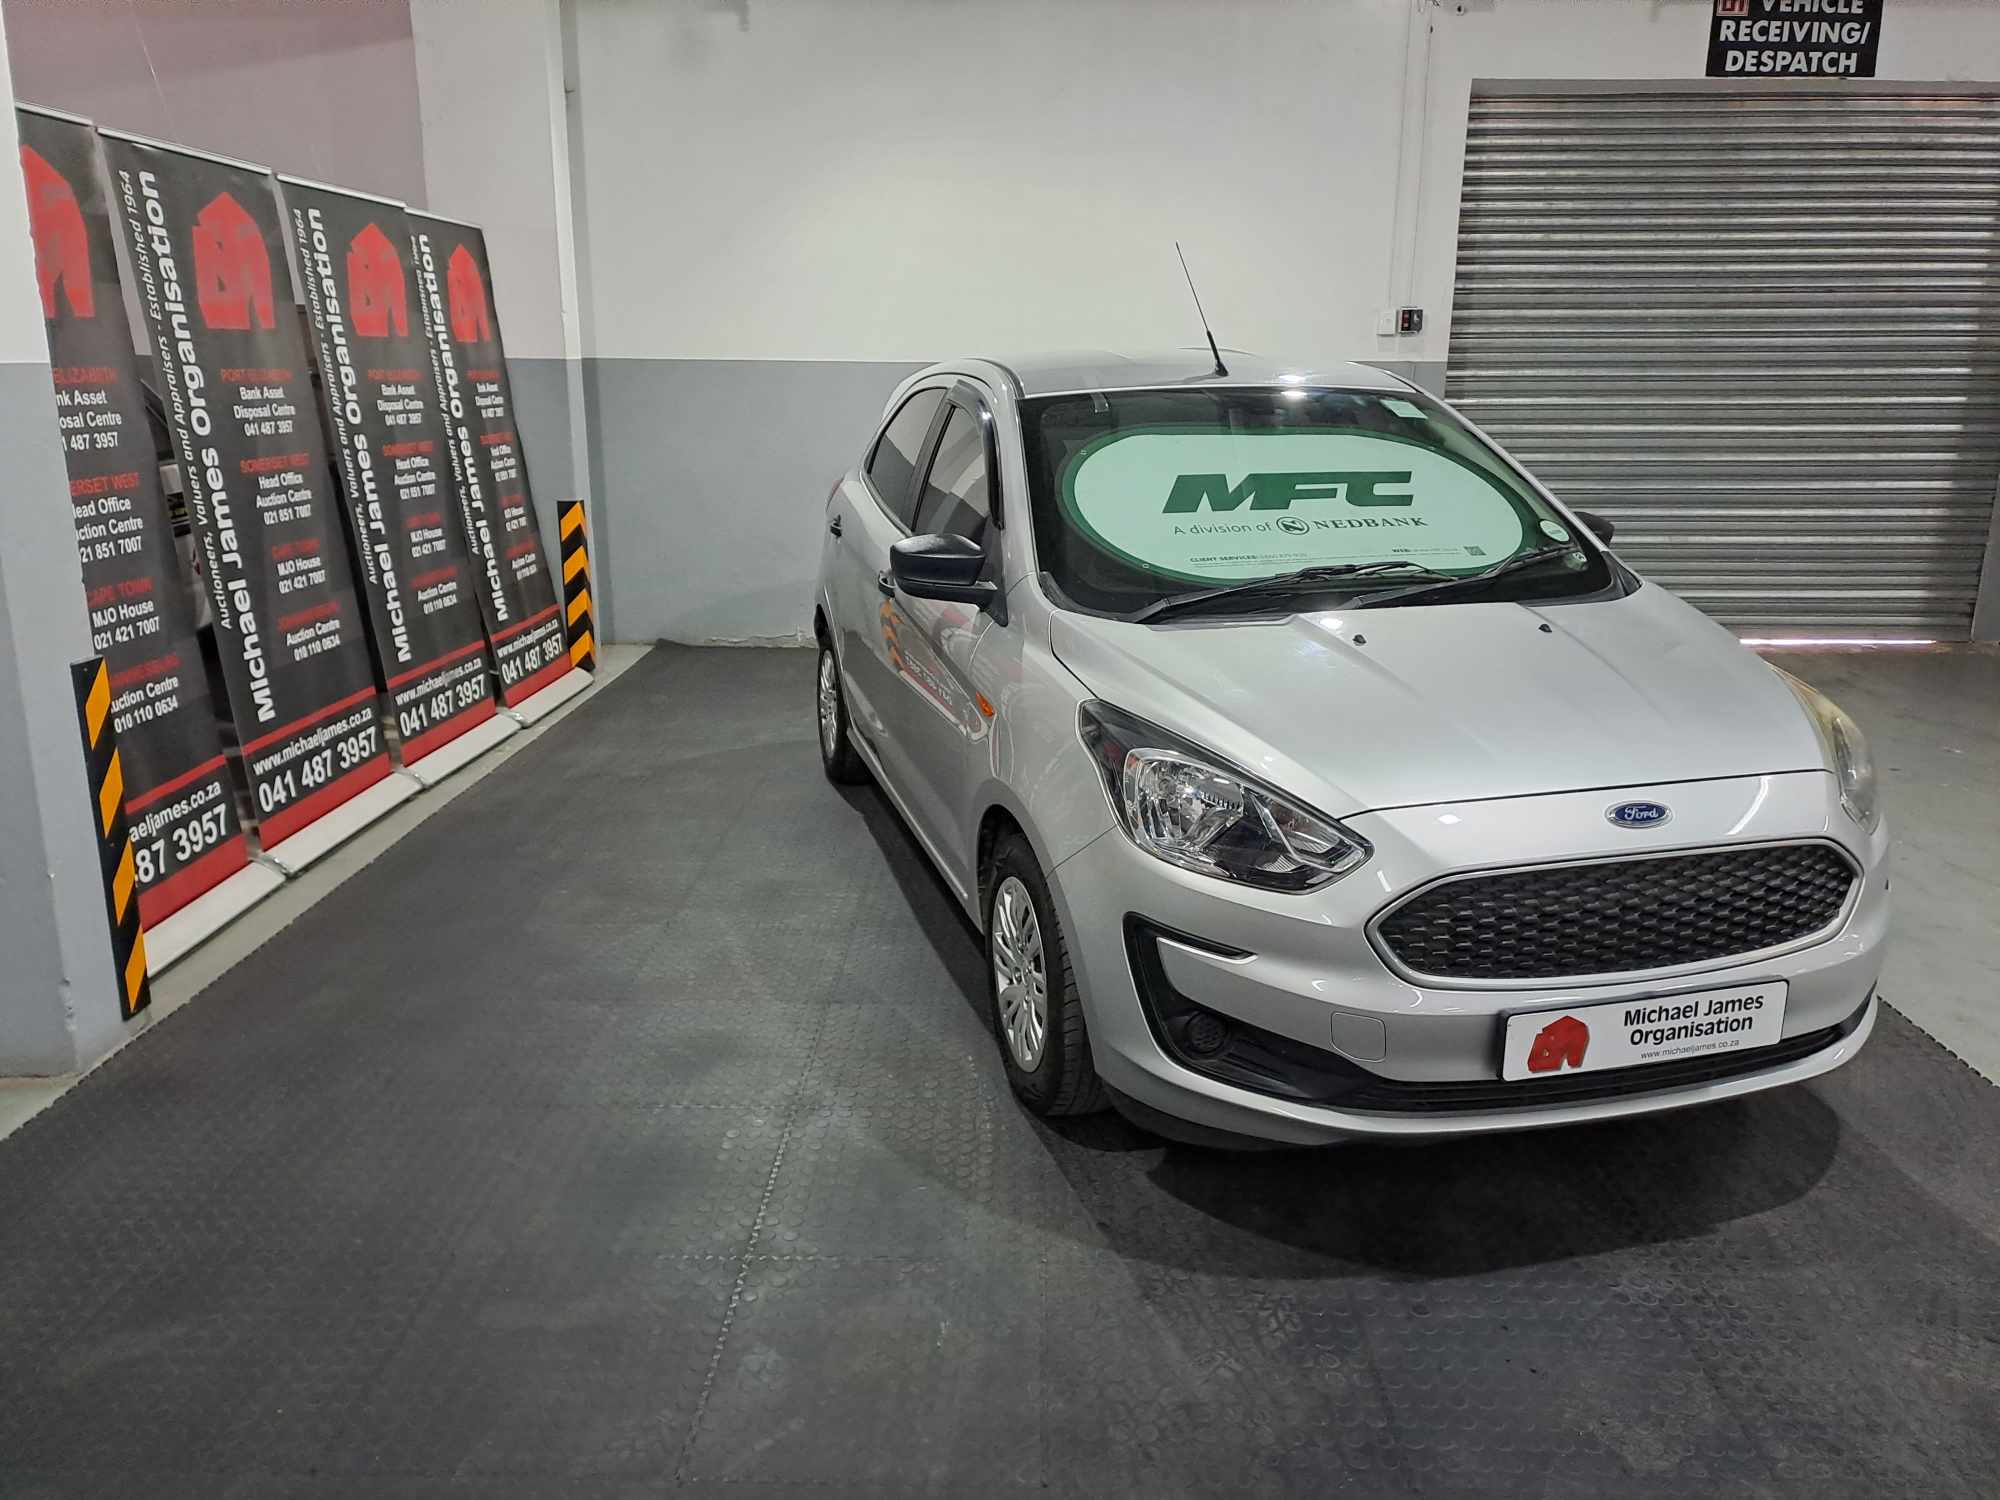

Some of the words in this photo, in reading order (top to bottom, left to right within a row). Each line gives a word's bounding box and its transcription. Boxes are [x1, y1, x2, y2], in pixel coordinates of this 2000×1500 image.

[1762, 0, 1864, 14] VEHICLE
[1719, 19, 1871, 44] RECEIVING/
[1725, 50, 1858, 73] DESPATCH
[118, 169, 140, 216] 1964
[128, 221, 162, 321] Established
[138, 170, 212, 437] Organisation
[308, 208, 362, 424] Organisation
[158, 335, 187, 424] Appraisers
[240, 387, 262, 400] Bank
[56, 390, 72, 406] nk
[74, 390, 108, 405] Asset
[233, 404, 270, 420] Disposal
[60, 412, 83, 429] osal
[87, 410, 122, 427] Centre
[333, 417, 348, 444] and
[70, 434, 90, 450] 487
[94, 432, 118, 448] 3957
[176, 429, 194, 461] and
[343, 448, 360, 498] Valuers
[354, 434, 386, 536] James
[457, 426, 485, 512] James
[70, 476, 109, 496] ERSET
[187, 465, 208, 526] Valuers
[256, 494, 286, 508] Auction
[1162, 471, 1414, 514] MFC
[98, 497, 131, 514] Office
[201, 447, 242, 569] James
[76, 522, 106, 540] ction
[109, 517, 143, 534] Centre
[1174, 525, 1186, 536] A
[1190, 520, 1252, 534] division
[1256, 520, 1272, 532] of
[1312, 516, 1428, 530] NEDBANK
[80, 547, 93, 563] 21
[96, 542, 116, 559] 851
[118, 536, 142, 554] 7007
[296, 557, 322, 570] House
[476, 520, 508, 622] Michael
[92, 608, 116, 628] MJO
[118, 600, 154, 619] House
[374, 543, 412, 664] Michael
[94, 634, 112, 650] 021
[115, 625, 134, 643] 421
[136, 616, 160, 636] 7007
[286, 628, 314, 646] Auction
[228, 578, 276, 722] Michael
[502, 654, 522, 684] 041
[524, 644, 542, 671] 487
[542, 633, 564, 661] 3957
[111, 693, 144, 714] uction
[146, 676, 179, 698] Centre
[400, 703, 428, 736] 041
[431, 690, 454, 721] 487
[456, 674, 485, 707] 3957
[114, 714, 132, 733] 010
[134, 706, 153, 724] 110
[253, 708, 372, 776] www.michaeljames.co.za
[258, 770, 296, 812] 041
[302, 749, 333, 788] 487
[337, 726, 376, 769] 3957
[128, 781, 221, 842] aeljames.co.za
[1624, 805, 1659, 820] Ford
[135, 838, 166, 888] 87
[173, 803, 228, 862] 3957
[1624, 1000, 1699, 1026] Michael
[1703, 995, 1764, 1016] James
[1630, 1016, 1753, 1046] Organisation
